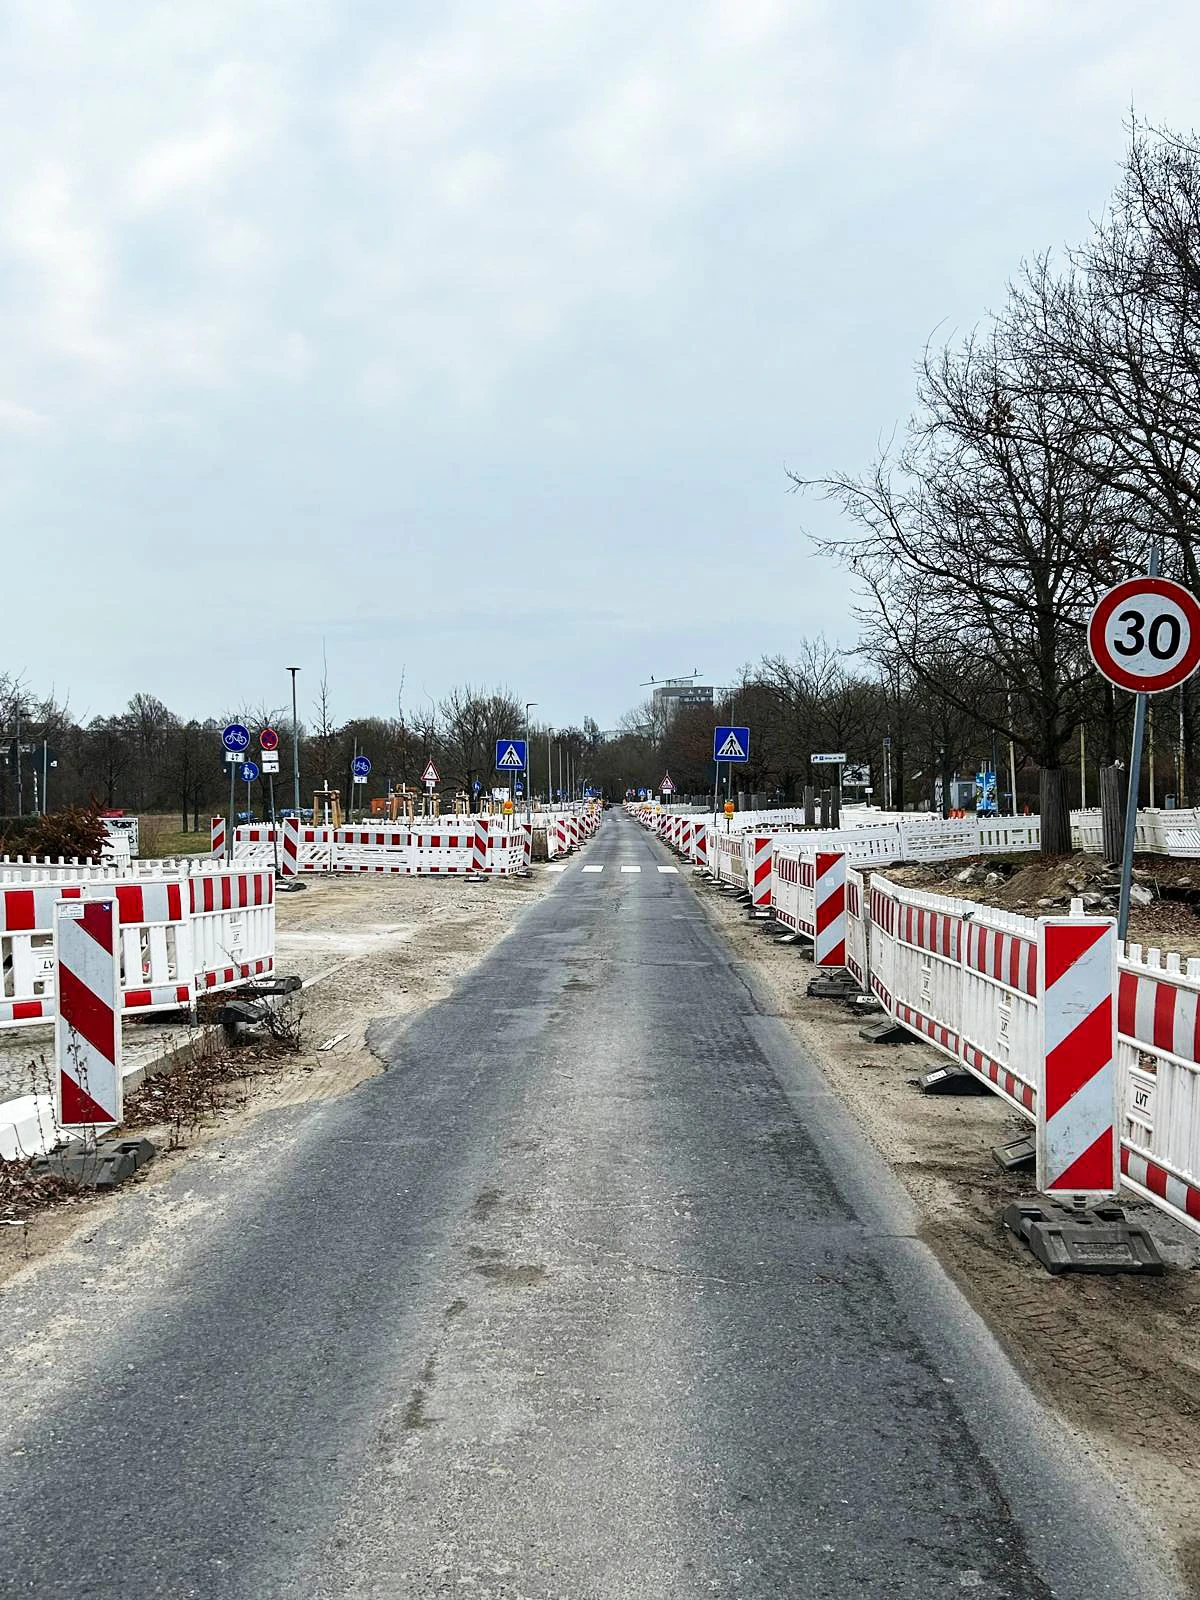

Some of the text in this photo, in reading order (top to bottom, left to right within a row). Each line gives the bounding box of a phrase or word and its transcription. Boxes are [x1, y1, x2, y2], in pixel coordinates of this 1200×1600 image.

[1113, 610, 1181, 660] 30
[44, 960, 54, 969] LV
[1135, 1090, 1149, 1107] LVT
